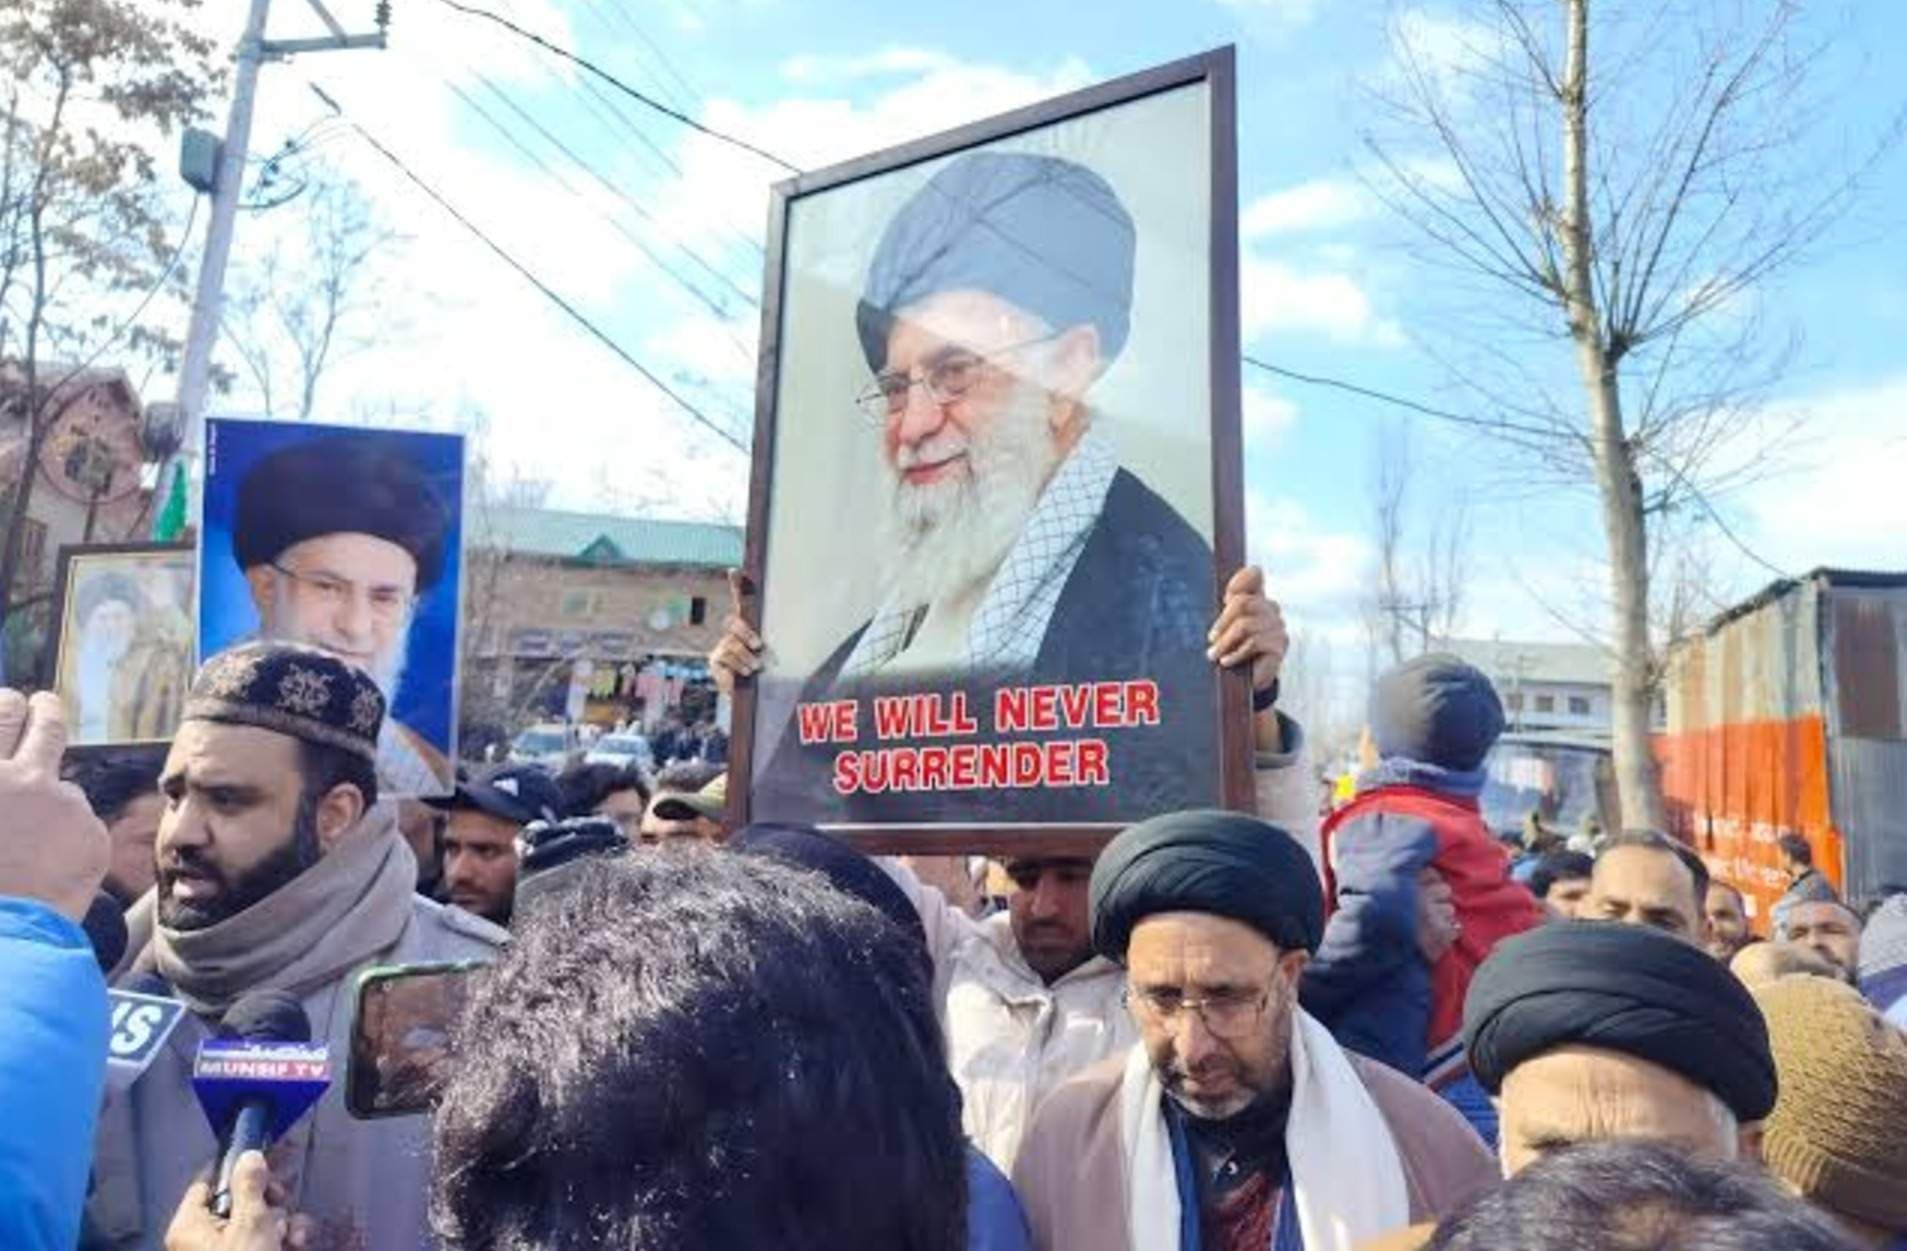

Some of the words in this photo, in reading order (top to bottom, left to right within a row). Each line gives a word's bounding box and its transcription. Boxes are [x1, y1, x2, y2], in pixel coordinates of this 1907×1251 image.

[800, 700, 858, 745] WE
[873, 692, 978, 740] WILL
[995, 678, 1161, 731] NEVER
[834, 738, 1110, 794] SURRENDER
[200, 1060, 289, 1076] MUNSIF
[294, 1062, 325, 1077] TV
